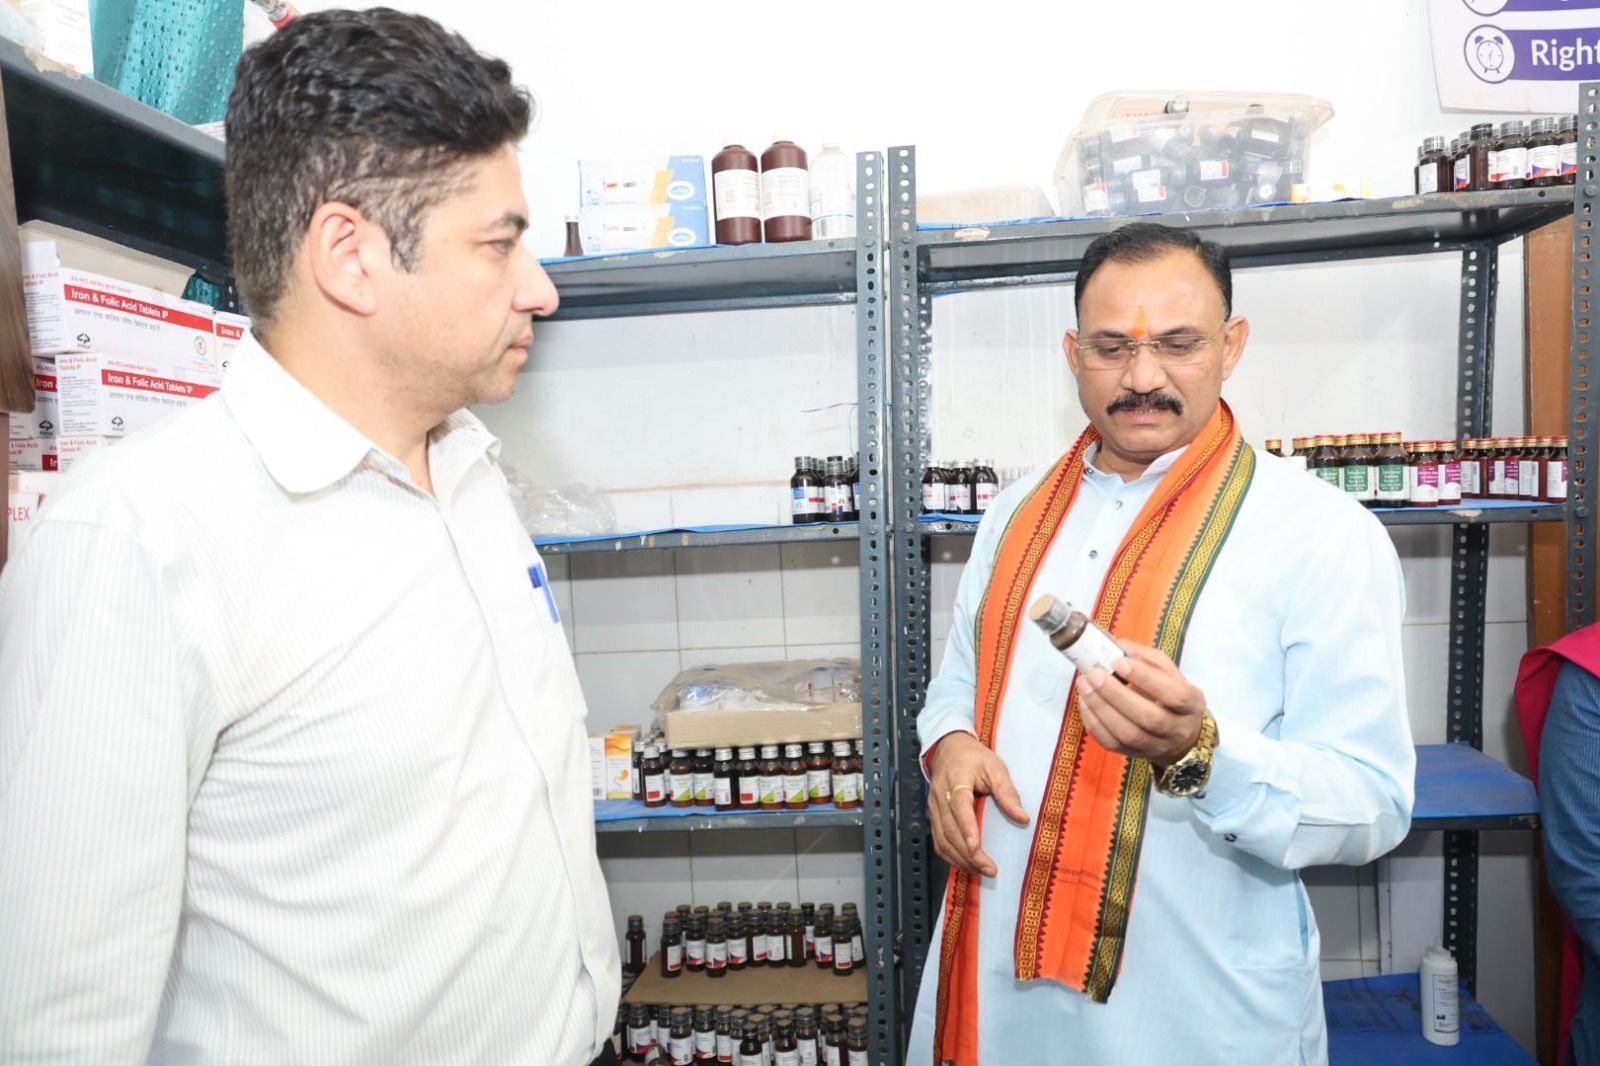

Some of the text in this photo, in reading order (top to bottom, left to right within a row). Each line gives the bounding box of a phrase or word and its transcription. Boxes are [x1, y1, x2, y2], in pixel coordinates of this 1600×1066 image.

[71, 288, 91, 301] Iron
[92, 294, 100, 303] &
[101, 295, 120, 308] Folic
[121, 301, 138, 312] Acid
[139, 304, 161, 318] Tablets
[161, 310, 169, 320] IP
[221, 326, 233, 337] Iron
[36, 377, 53, 389] Iron
[107, 373, 194, 394] Iron & Folic Acid Tablets IP
